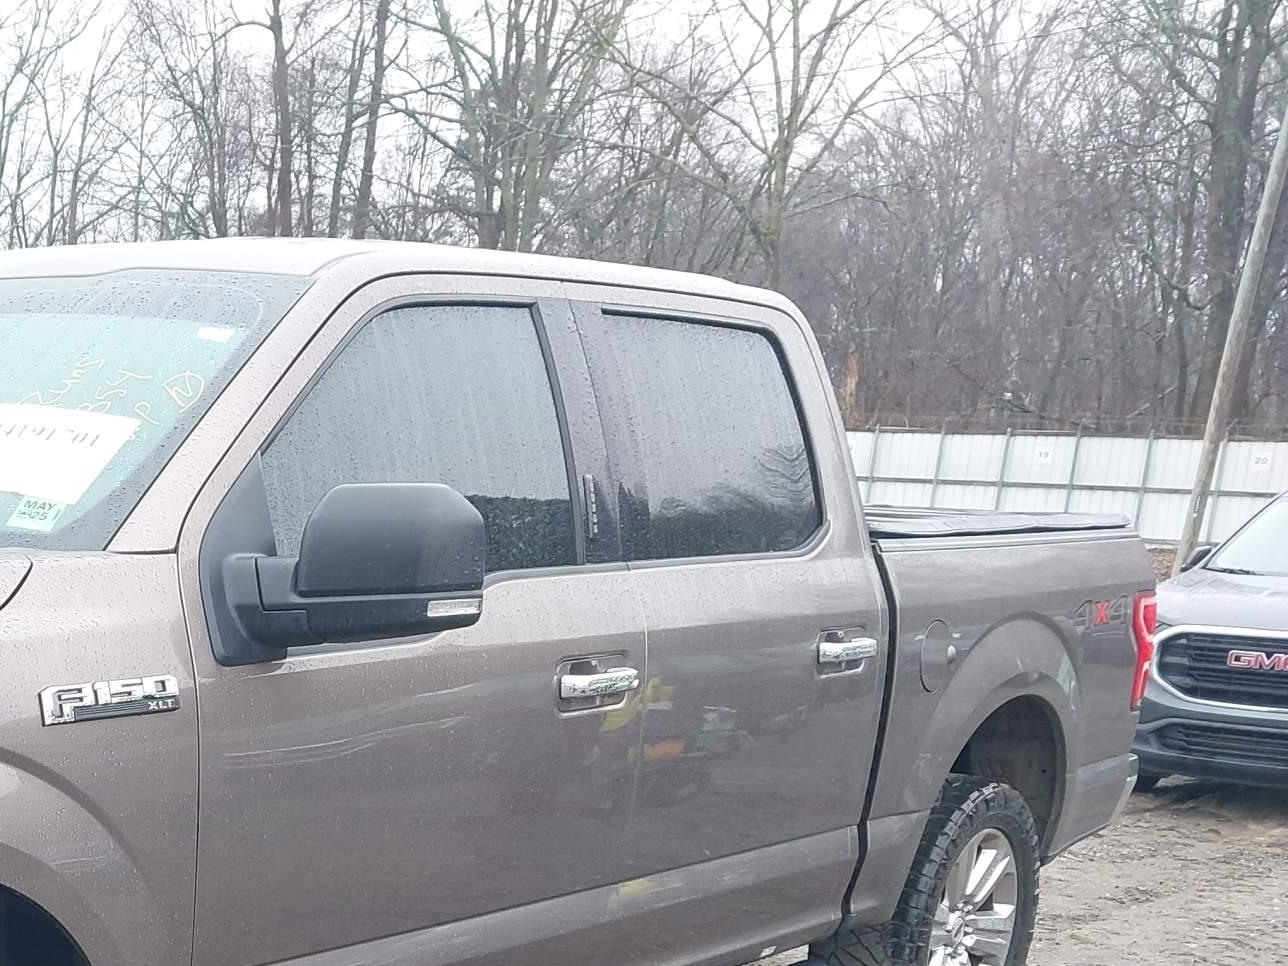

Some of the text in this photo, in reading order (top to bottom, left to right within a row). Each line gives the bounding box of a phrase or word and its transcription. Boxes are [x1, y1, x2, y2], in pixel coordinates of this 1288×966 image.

[24, 499, 57, 511] MAY
[16, 510, 49, 521] 25
[147, 700, 175, 711] XLT
